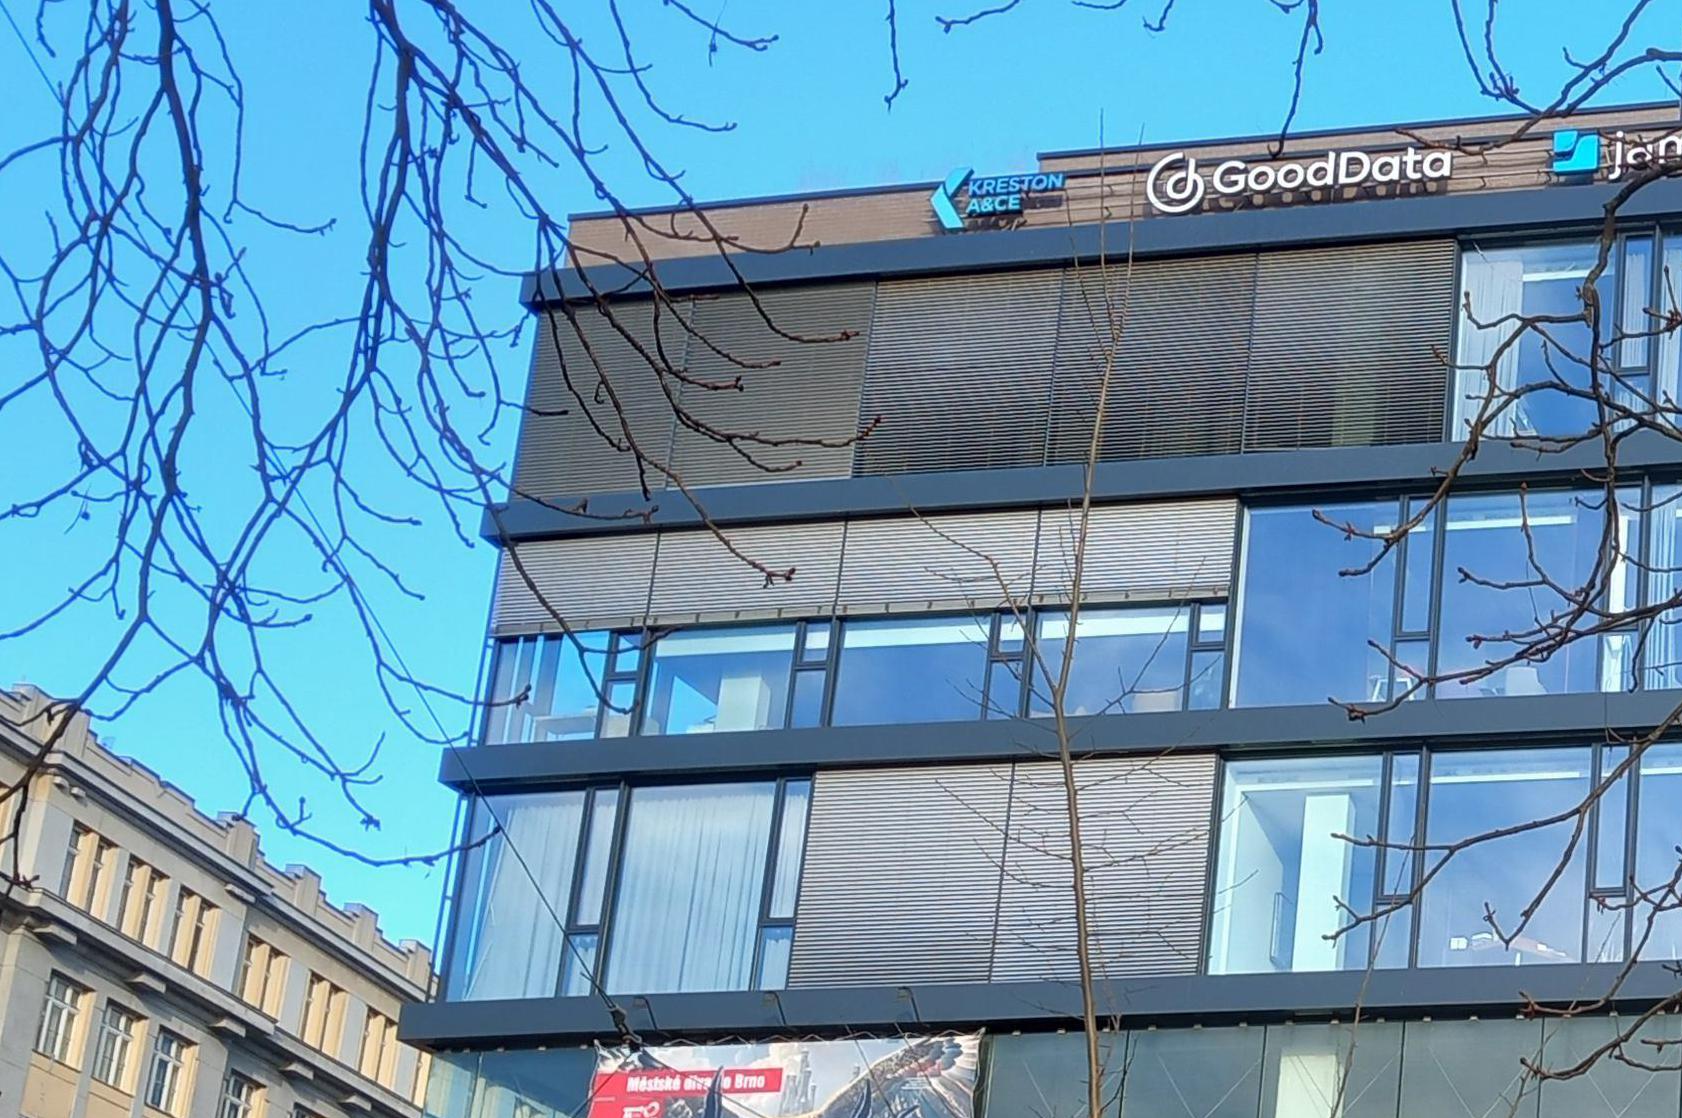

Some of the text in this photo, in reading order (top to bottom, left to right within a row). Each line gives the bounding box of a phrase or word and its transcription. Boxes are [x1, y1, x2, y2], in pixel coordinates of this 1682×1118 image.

[1212, 147, 1451, 194] GoodData
[968, 173, 1063, 196] KRESTON
[966, 194, 1021, 214] A&CE
[684, 1074, 731, 1091] divao
[735, 1073, 766, 1089] Brno
